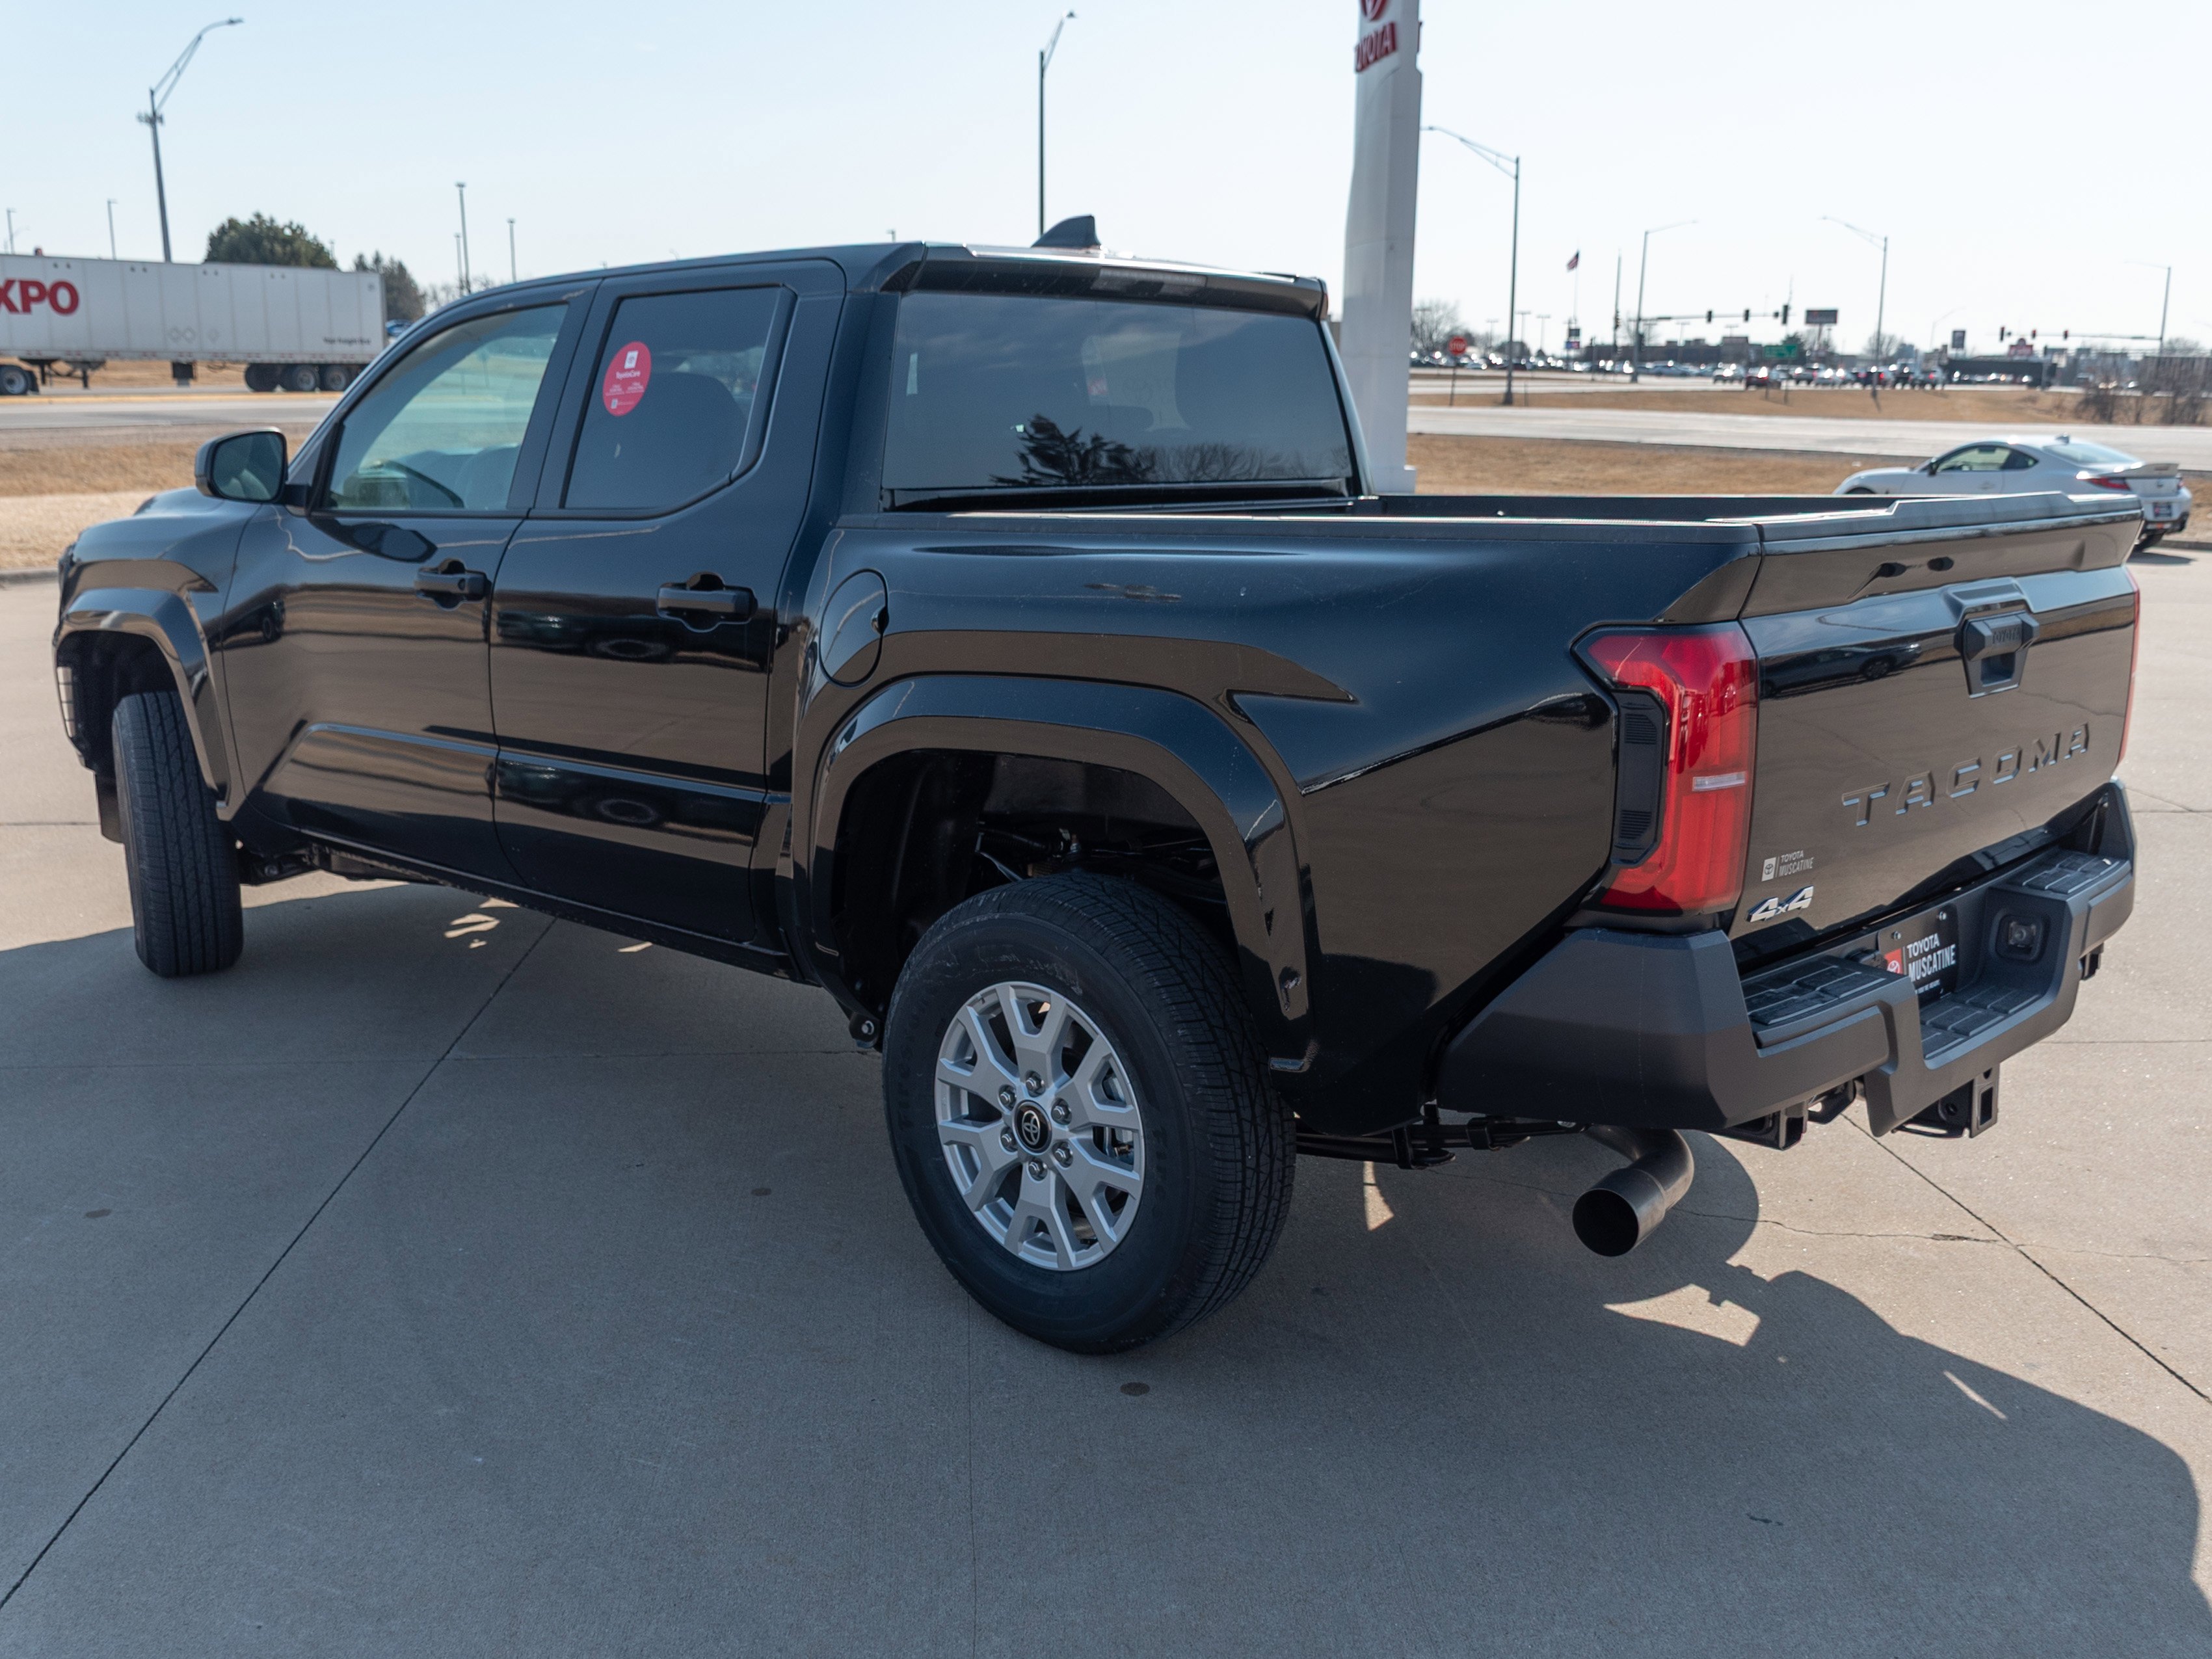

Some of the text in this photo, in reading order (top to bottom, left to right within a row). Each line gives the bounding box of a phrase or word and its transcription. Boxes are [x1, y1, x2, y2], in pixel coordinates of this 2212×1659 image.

[0, 279, 79, 316] XPO
[1841, 723, 2089, 826] TACOMA
[1778, 856, 1814, 877] MUSCATINE
[1781, 850, 1804, 863] TOYOTA
[1907, 933, 1939, 959] TOYOTA
[1908, 944, 1956, 982] MUSCATINE
